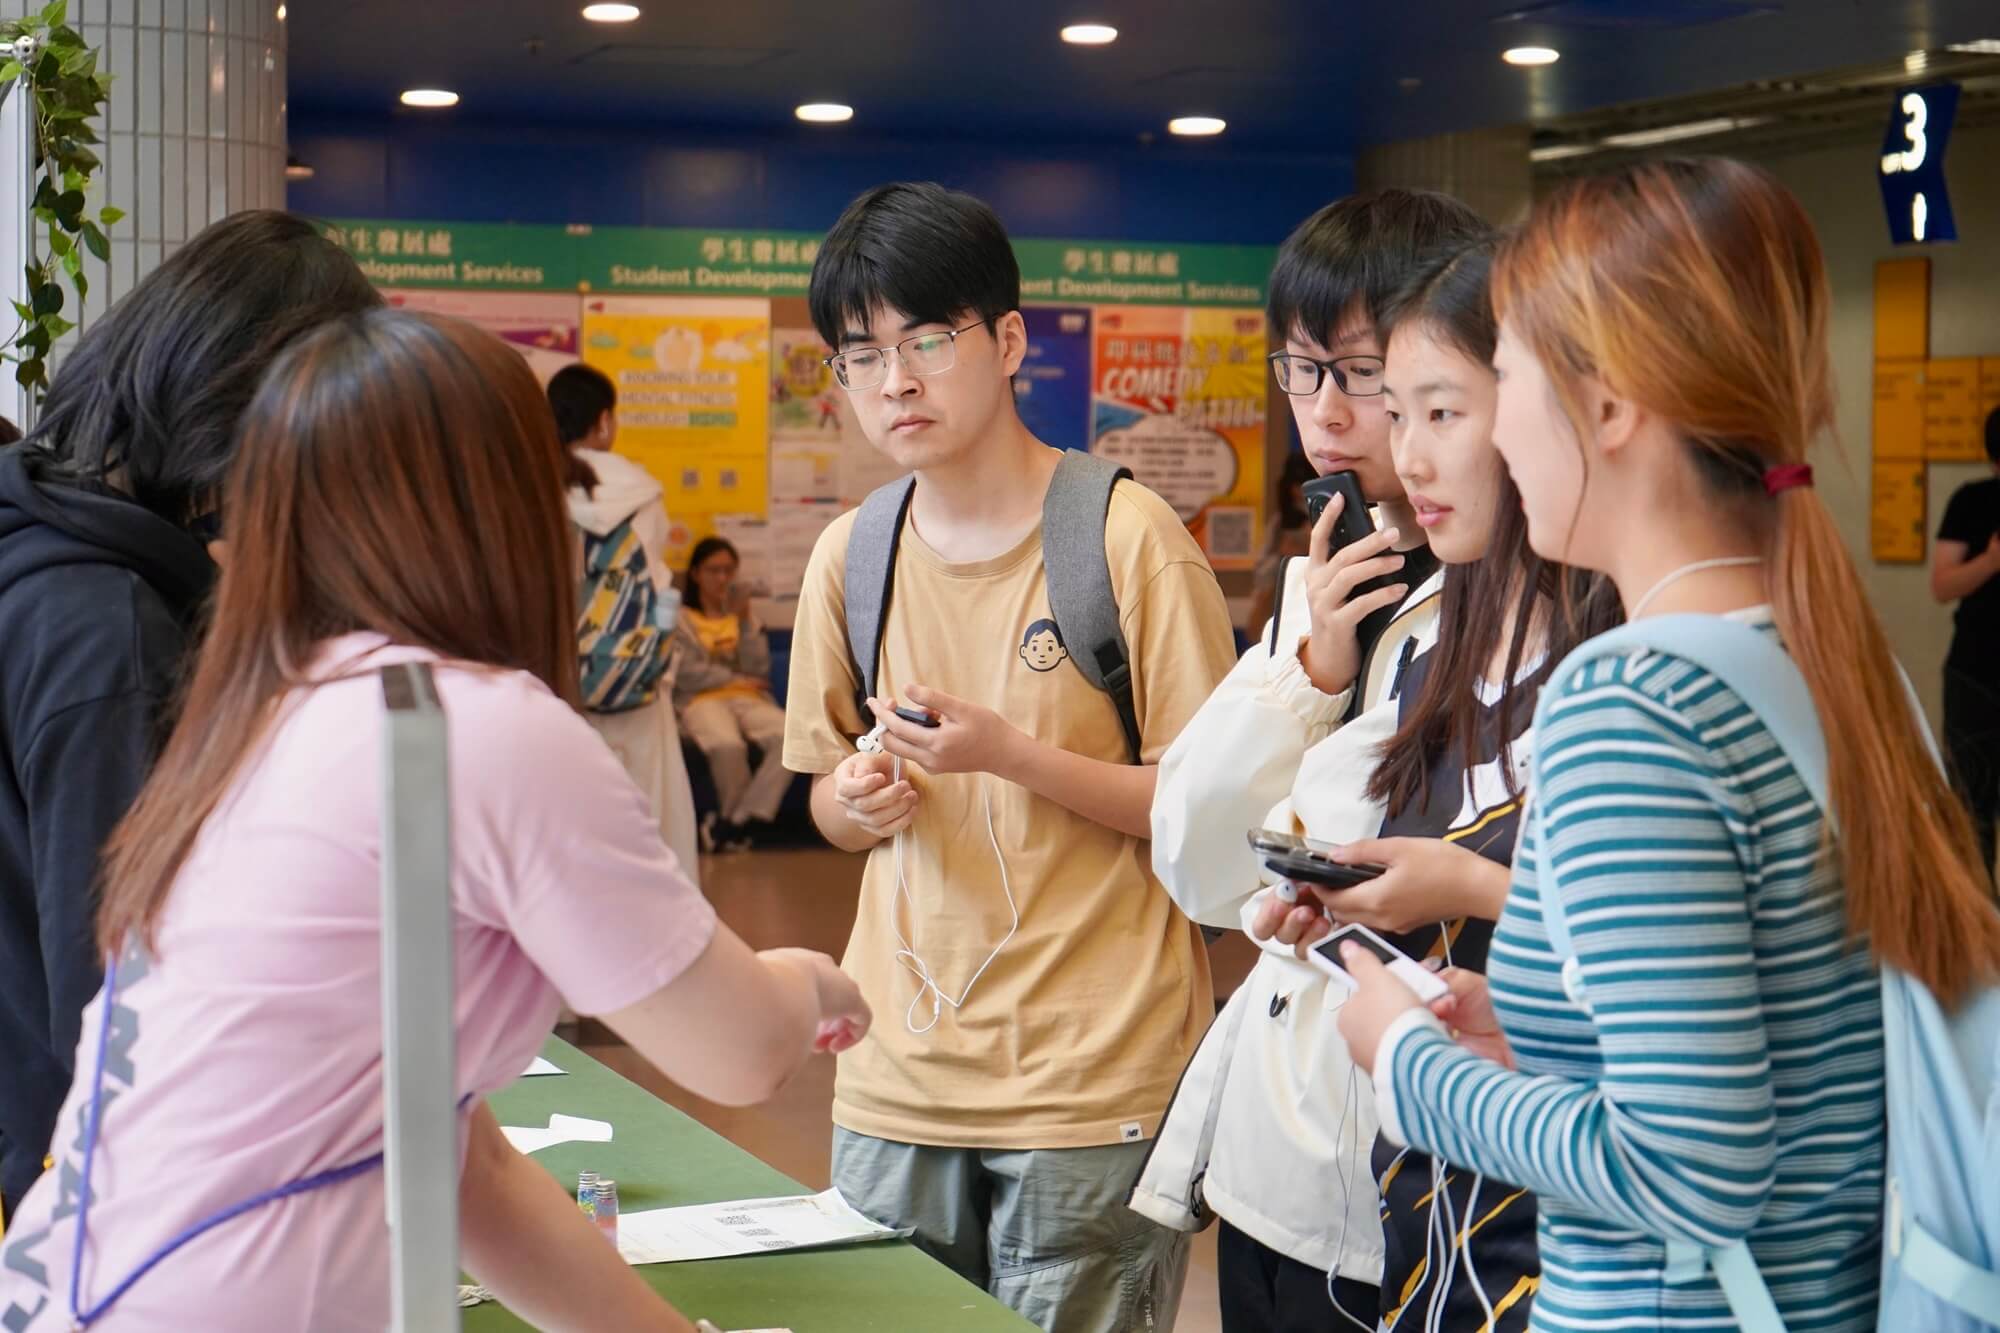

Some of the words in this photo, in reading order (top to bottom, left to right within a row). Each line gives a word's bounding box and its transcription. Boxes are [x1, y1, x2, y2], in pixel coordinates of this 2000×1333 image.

[462, 260, 545, 284] Services
[611, 265, 690, 286] Student
[1059, 279, 1180, 298] Development
[1190, 283, 1259, 300] Services
[1104, 368, 1207, 397] COMEDY
